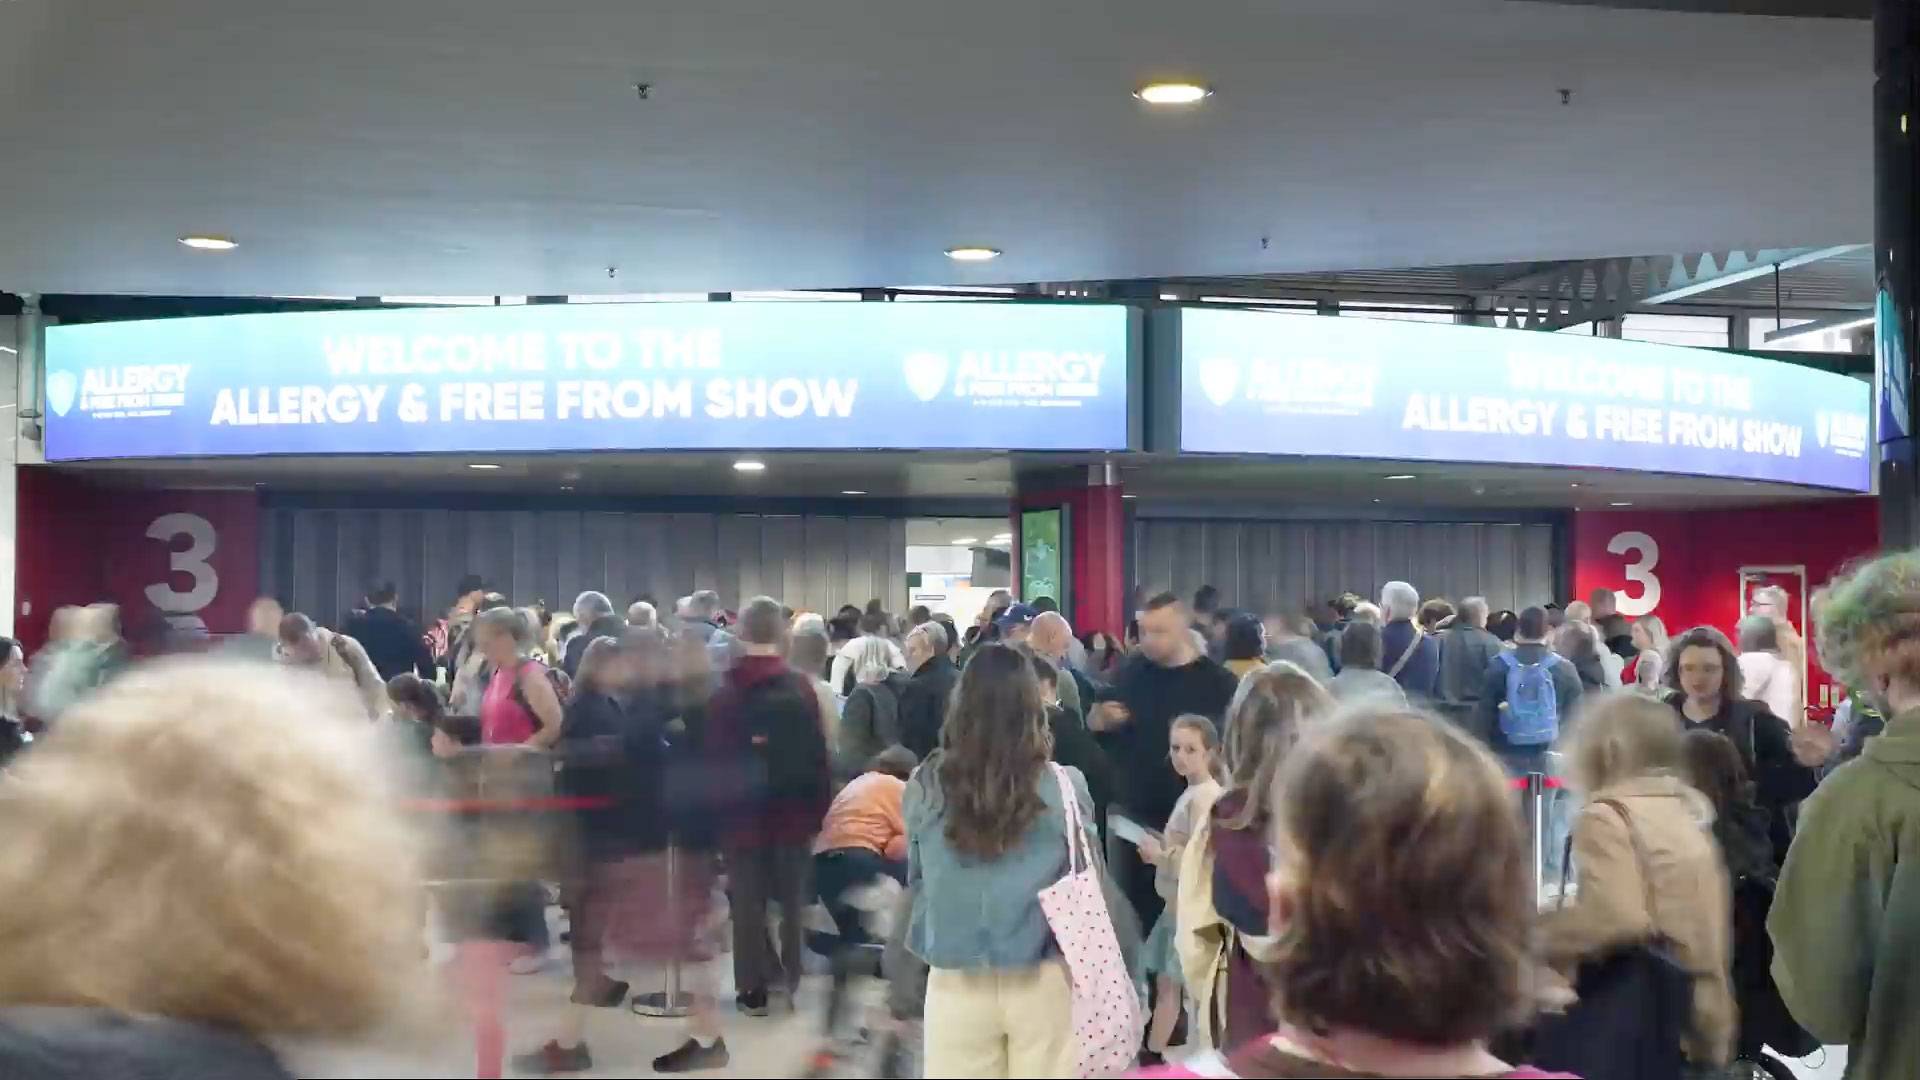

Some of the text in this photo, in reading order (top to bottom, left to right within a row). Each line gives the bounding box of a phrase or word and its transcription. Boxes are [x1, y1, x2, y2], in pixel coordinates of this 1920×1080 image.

[323, 329, 723, 375] WELCOME TO THE
[956, 350, 1105, 382] ALLERGY
[82, 363, 192, 395] ALLERGY
[210, 377, 858, 426] ALLERGY & FREE FROM SHOW
[1401, 391, 1557, 437] ALLERGY
[1565, 402, 1588, 439] &
[1595, 404, 1663, 443] FREE
[1669, 410, 1738, 450] FROM
[1743, 420, 1803, 458] SHOW
[144, 512, 219, 612] 3
[1607, 531, 1661, 616] 3
